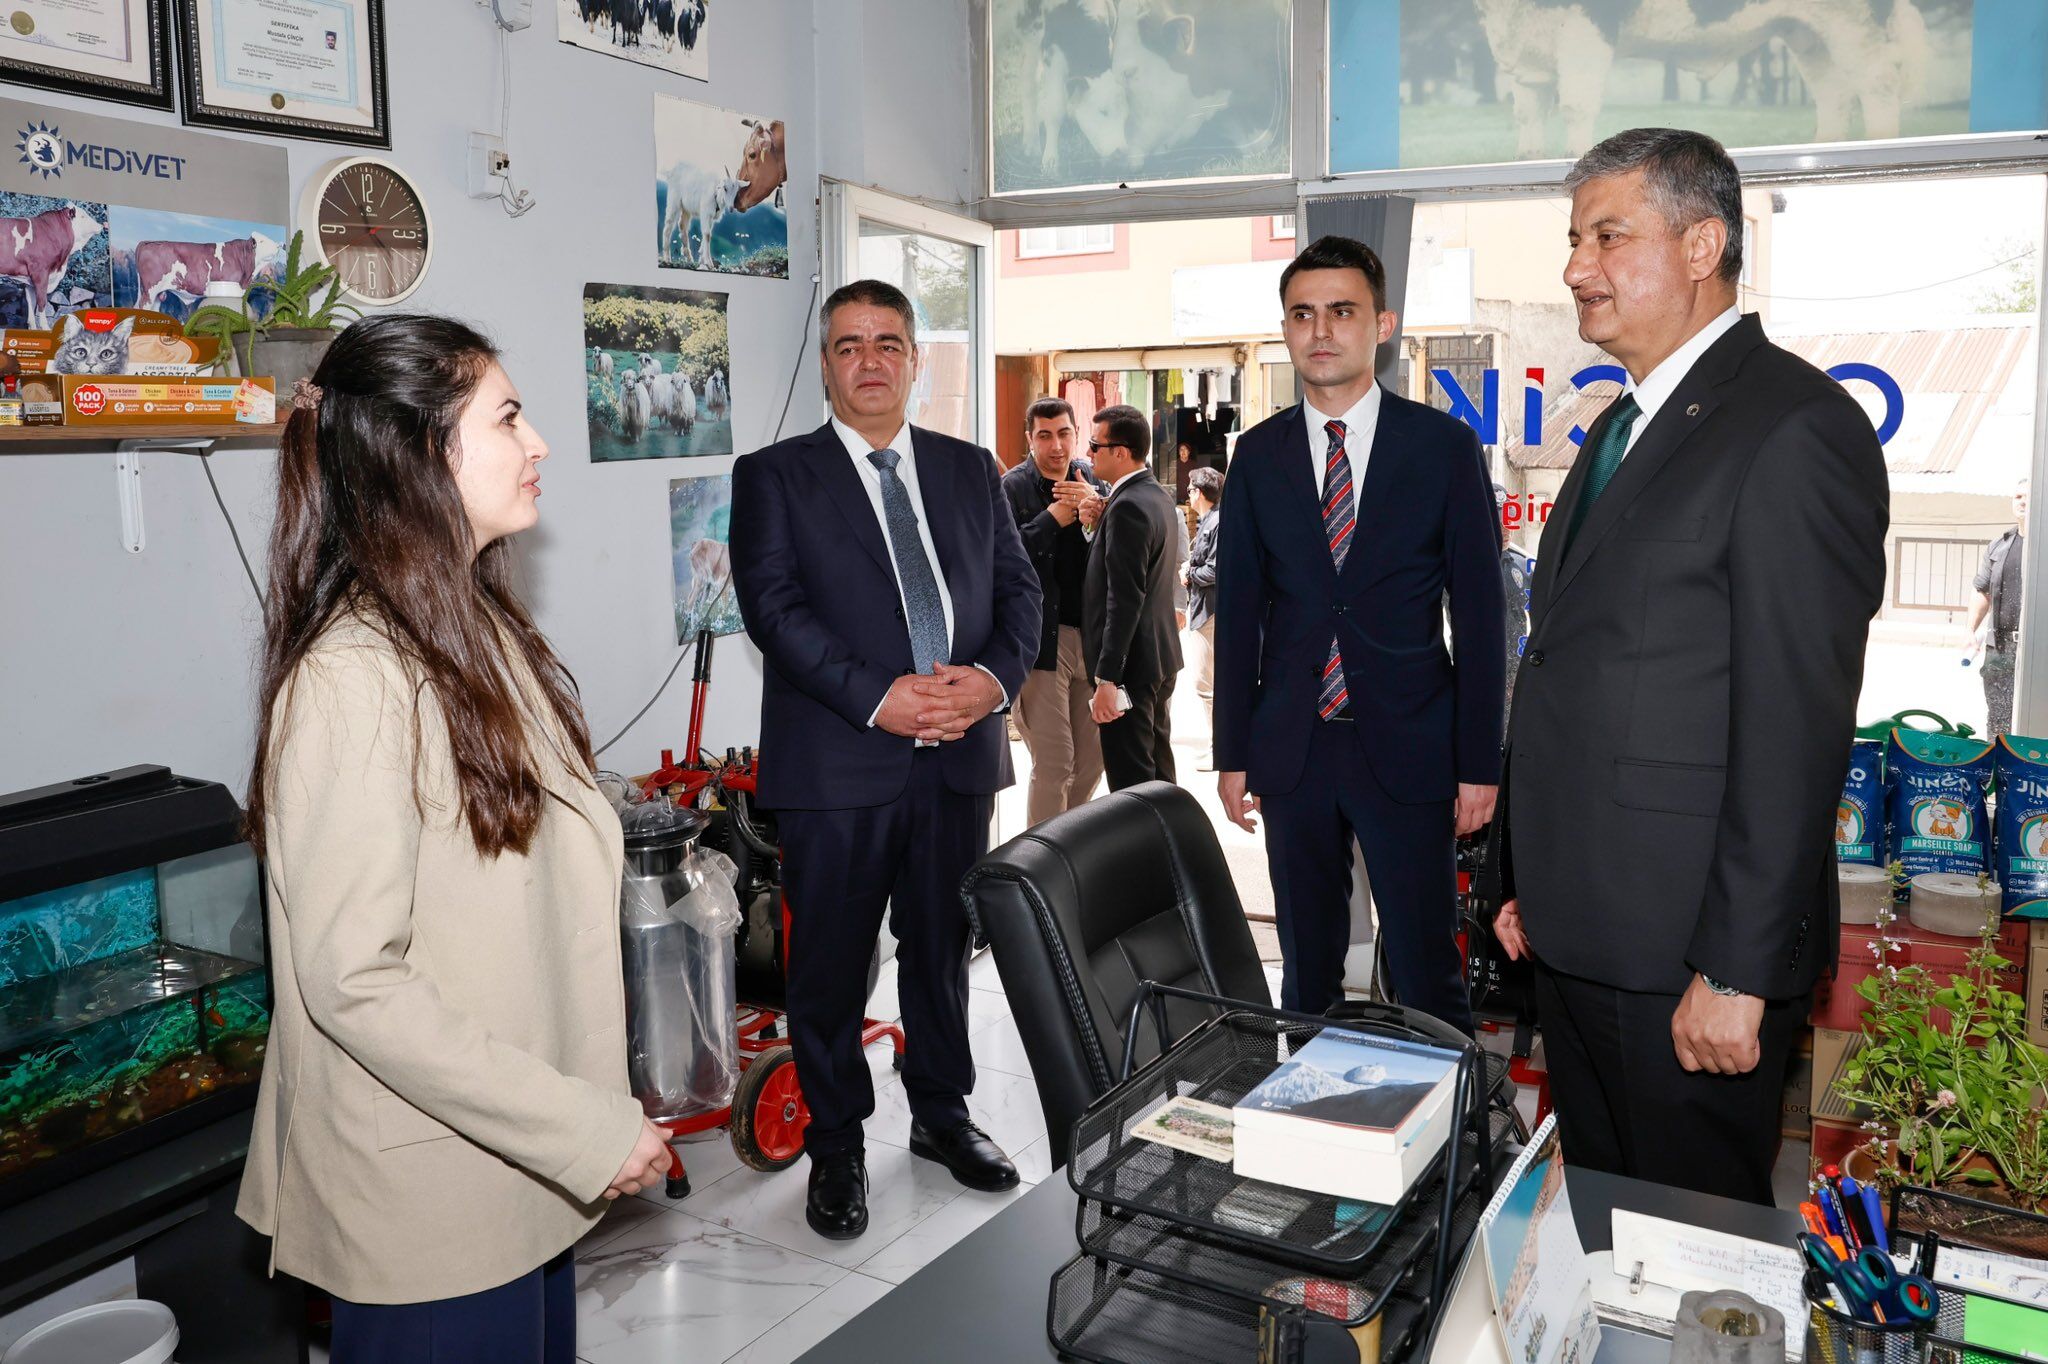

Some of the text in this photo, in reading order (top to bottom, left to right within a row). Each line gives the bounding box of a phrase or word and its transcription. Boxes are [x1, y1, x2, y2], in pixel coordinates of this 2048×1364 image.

[361, 173, 374, 203] 12
[368, 261, 376, 290] 6
[77, 391, 101, 402] 100
[2016, 780, 2048, 798] JIN
[1844, 845, 1863, 856] SOAP
[1912, 839, 1973, 852] MARSEILLE SOAP
